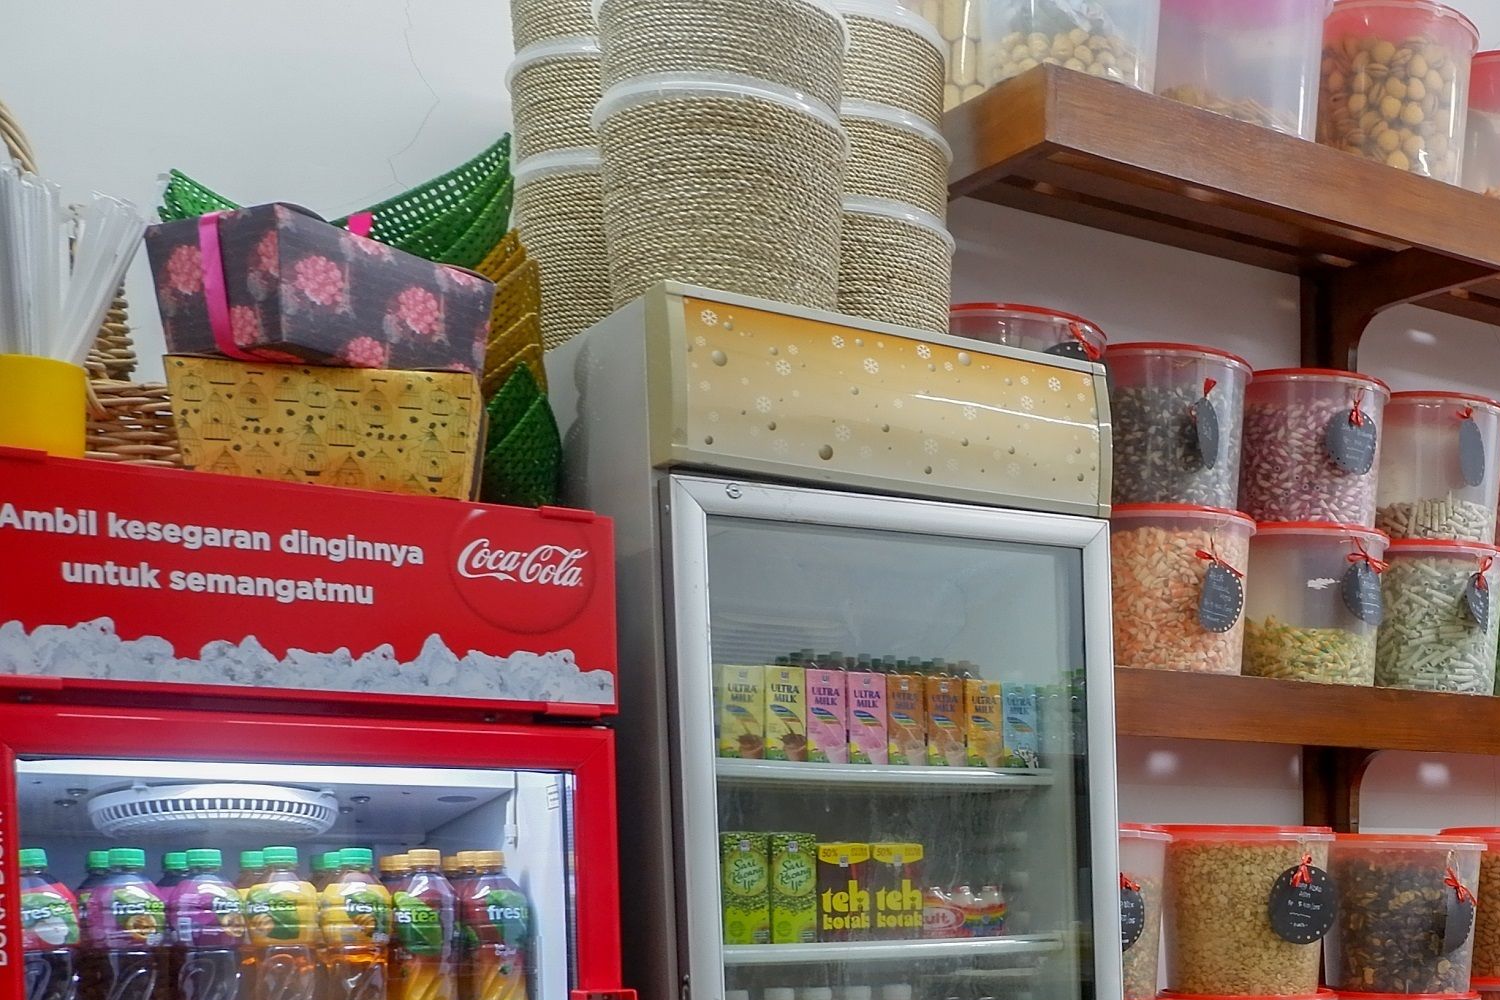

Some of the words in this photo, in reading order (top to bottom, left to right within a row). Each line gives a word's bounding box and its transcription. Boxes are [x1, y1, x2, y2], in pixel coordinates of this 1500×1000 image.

[0, 503, 97, 537] Ambil
[108, 512, 270, 551] kesegaran
[280, 530, 424, 568] dinginnya
[456, 536, 590, 589] Coca-Cola
[62, 561, 162, 589] untuk
[169, 568, 374, 605] semangatmu
[771, 684, 799, 694] ULTRA
[812, 687, 840, 697] ULTRA
[854, 689, 880, 700] ULTRA
[774, 693, 797, 704] MILK
[815, 696, 837, 706] MILK
[857, 697, 878, 708] MILK
[822, 879, 870, 913] teh
[876, 879, 922, 912] teh
[212, 897, 241, 913] fres
[247, 899, 297, 913] restea
[823, 912, 870, 930] kotak
[877, 911, 923, 929] kotak
[924, 912, 950, 924] ult
